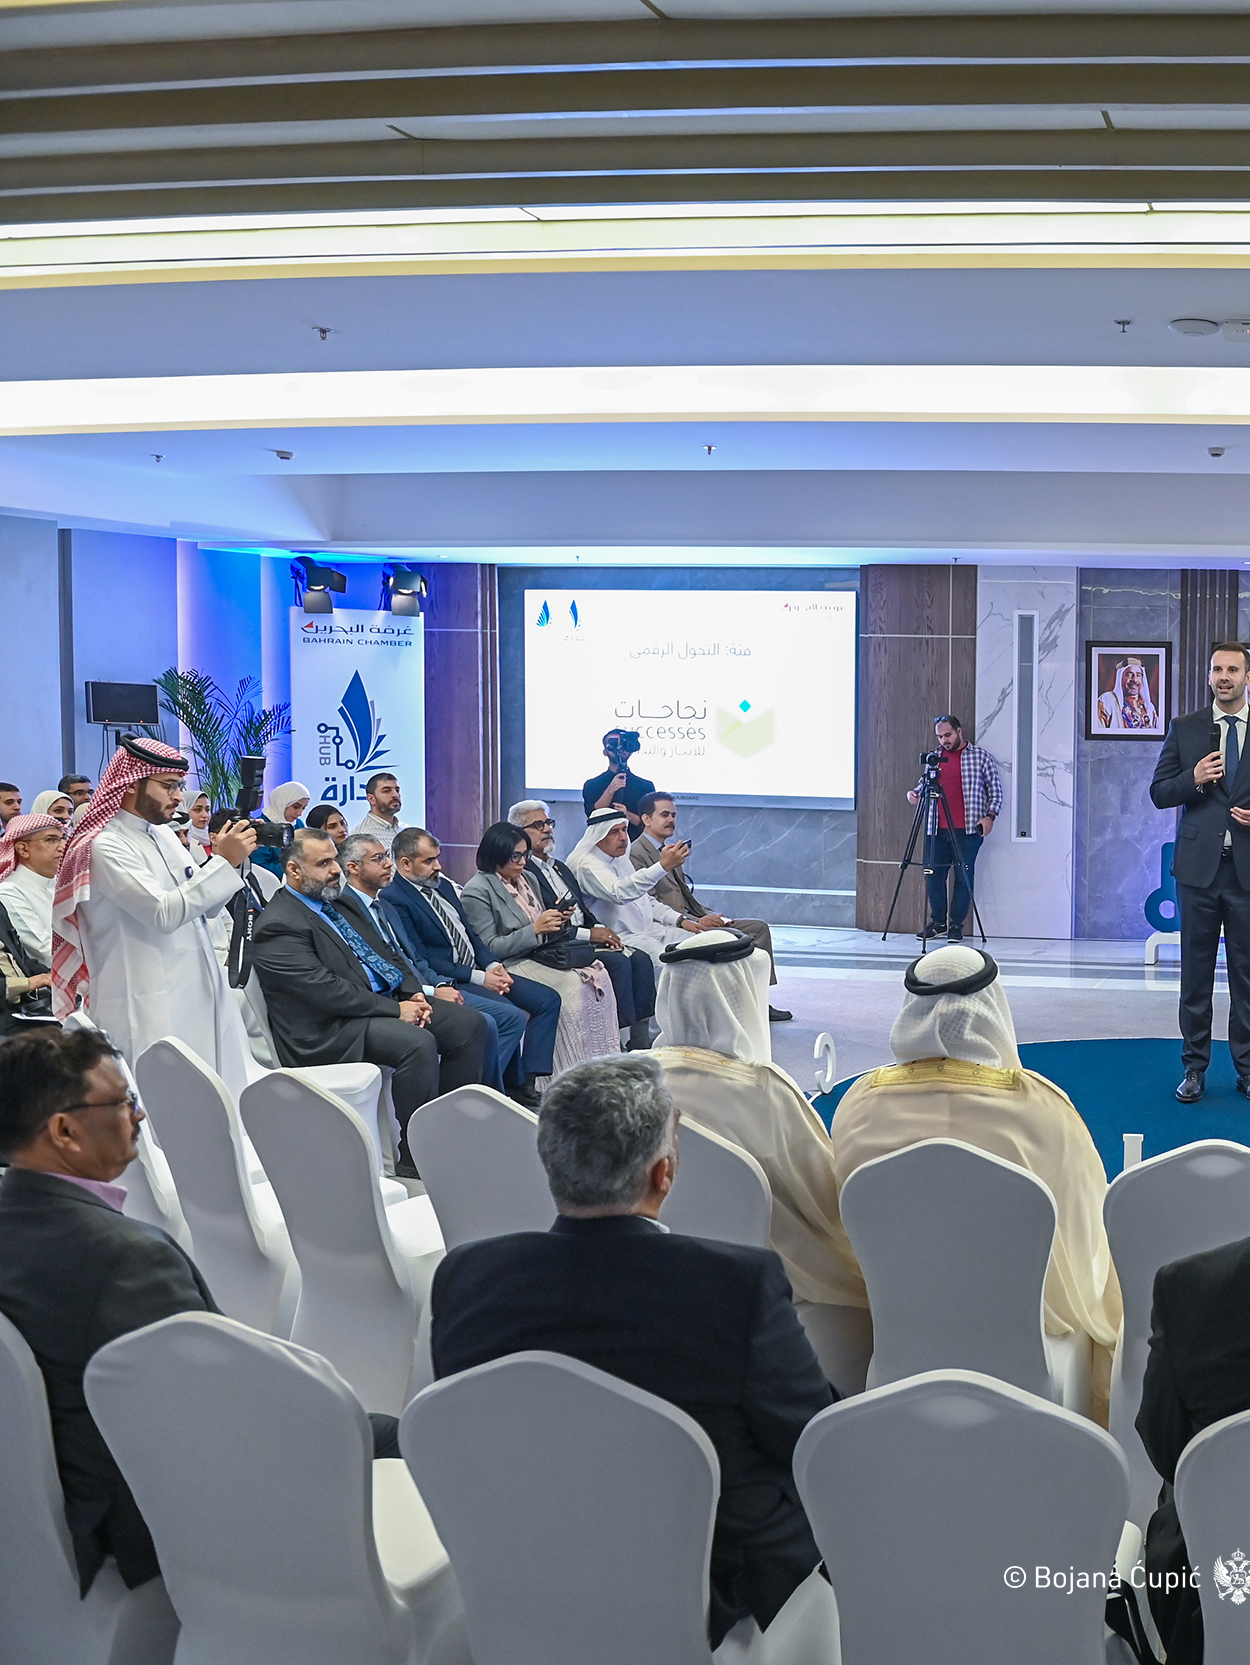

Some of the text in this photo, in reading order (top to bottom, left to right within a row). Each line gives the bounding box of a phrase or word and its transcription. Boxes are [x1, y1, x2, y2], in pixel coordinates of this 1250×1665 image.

[301, 621, 414, 636] غرفة البحرين
[302, 637, 413, 647] BAHRAIN CHAMBER
[615, 726, 706, 741] ccesses
[319, 735, 331, 766] HUB
[321, 776, 368, 807] دارة
